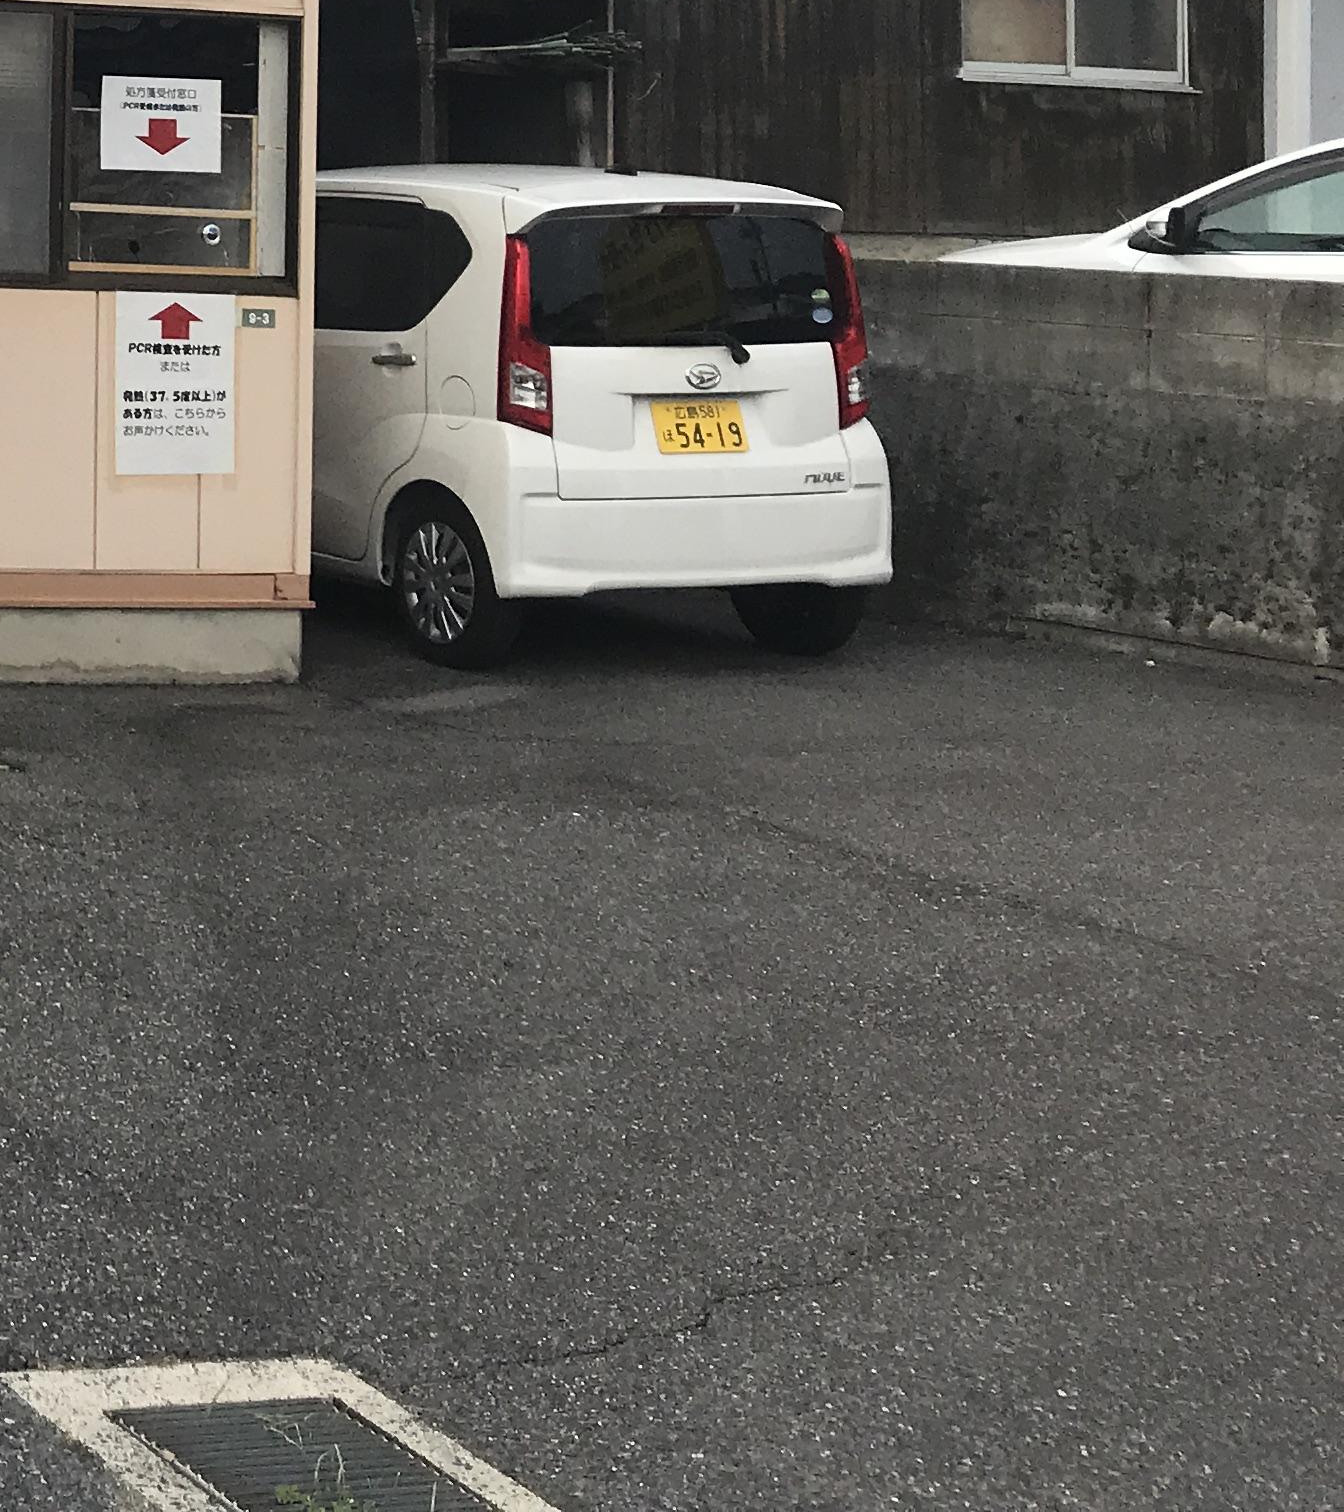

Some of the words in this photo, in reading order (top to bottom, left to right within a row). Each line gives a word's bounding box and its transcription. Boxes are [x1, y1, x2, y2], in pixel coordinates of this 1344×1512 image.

[159, 361, 191, 373] または
[123, 425, 210, 437] お声かけください。
[675, 421, 743, 448] 54-19
